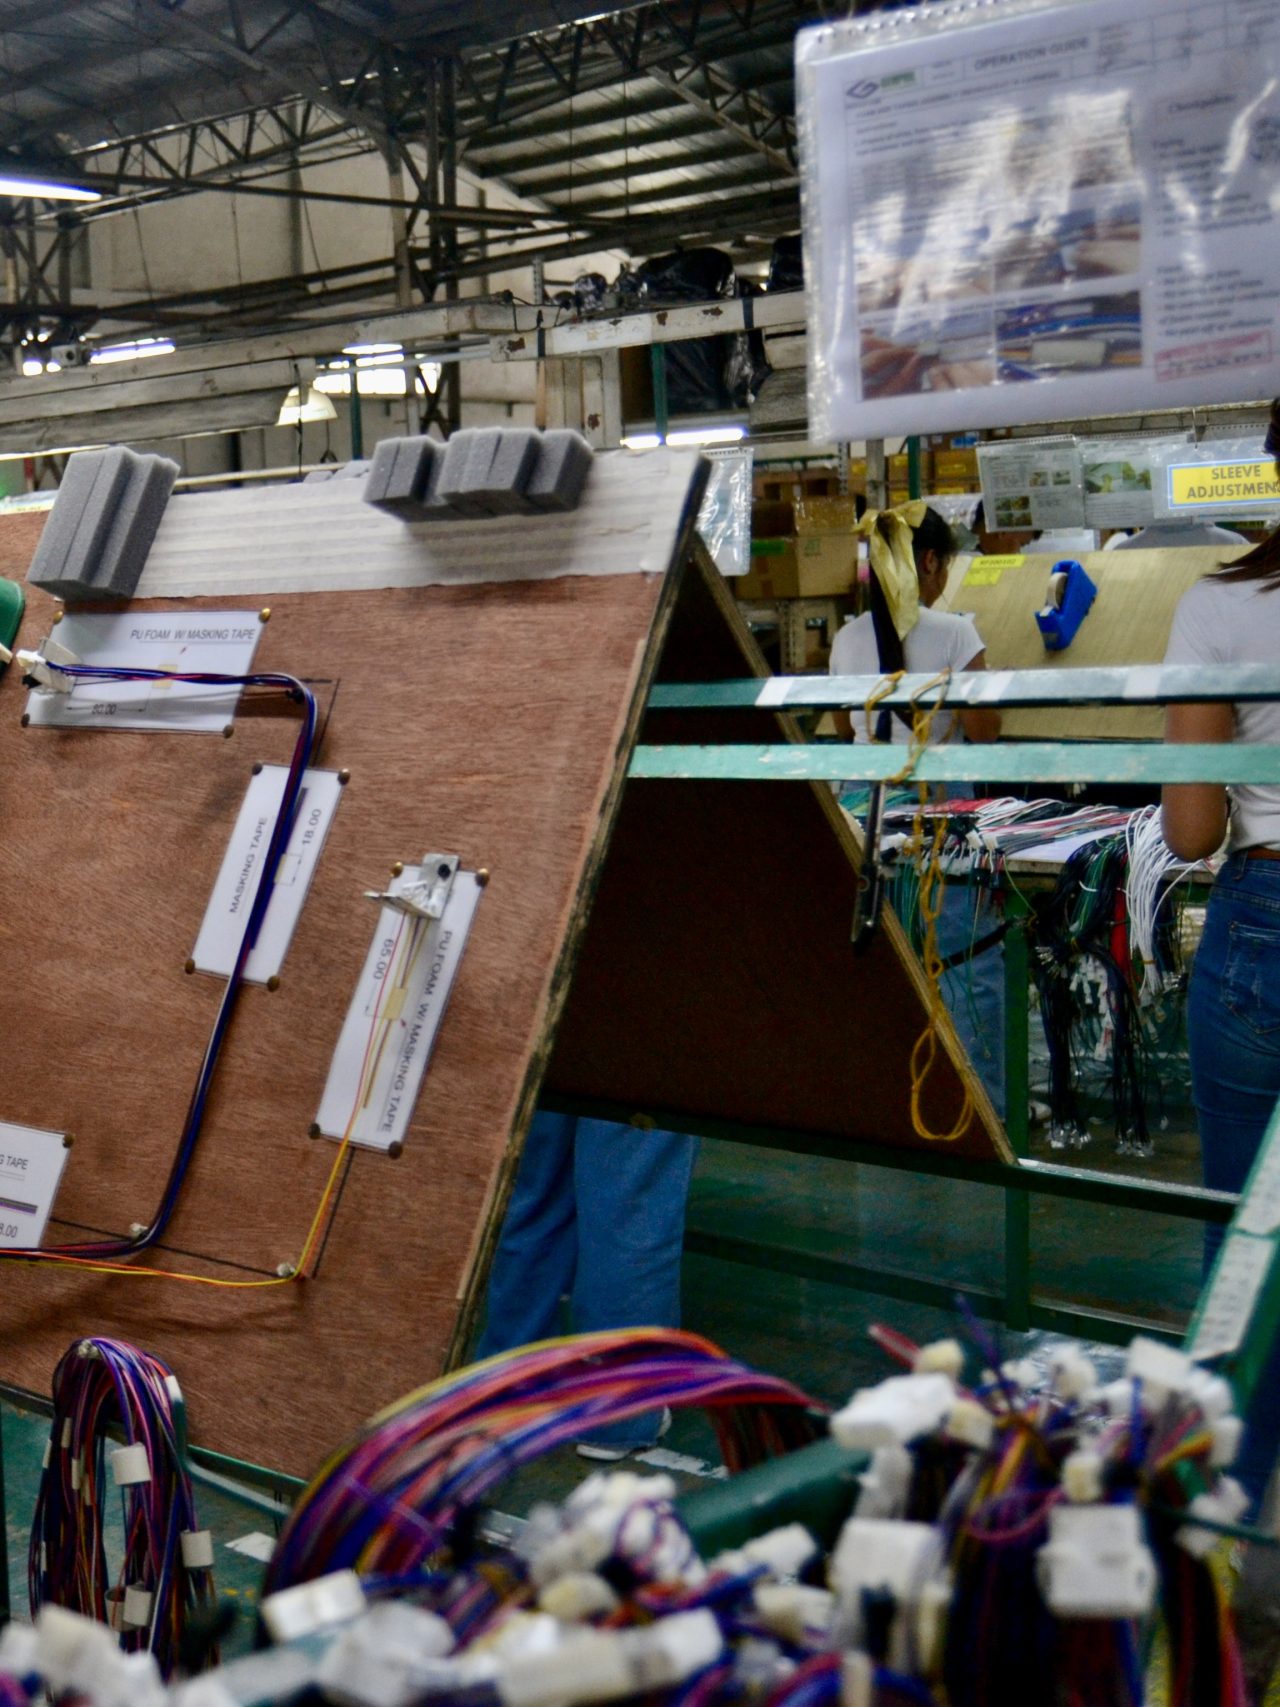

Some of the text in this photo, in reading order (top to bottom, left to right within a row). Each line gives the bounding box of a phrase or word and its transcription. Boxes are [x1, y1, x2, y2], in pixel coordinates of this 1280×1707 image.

[1186, 482, 1279, 499] ADJUSTMEN
[1211, 464, 1261, 480] SLEEVE
[130, 629, 144, 640] PU
[144, 629, 170, 640] FOAM
[187, 629, 229, 640] MASKING
[231, 629, 256, 640] TAPE
[302, 808, 322, 845] 18.00
[229, 817, 267, 913] MASKING TAPE
[373, 938, 394, 980] 65.00
[438, 930, 453, 951] PU
[424, 954, 445, 995] FOAM
[395, 1024, 422, 1091] MASKING
[382, 1095, 400, 1132] TAPE
[6, 1156, 28, 1169] TAPE
